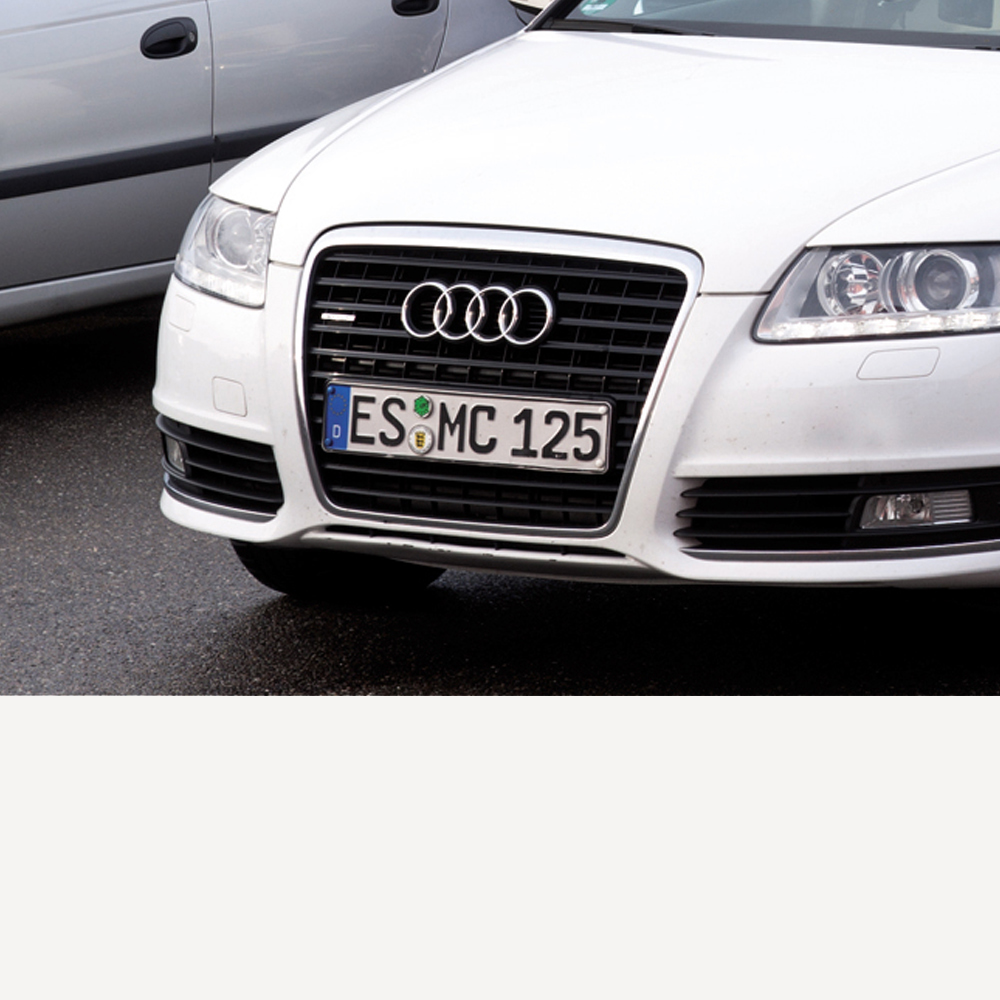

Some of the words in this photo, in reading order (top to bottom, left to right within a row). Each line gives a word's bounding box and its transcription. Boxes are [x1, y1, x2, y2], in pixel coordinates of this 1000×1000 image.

[332, 424, 341, 438] D
[351, 395, 406, 447] ES
[437, 402, 497, 454] MC
[511, 409, 603, 461] 125
